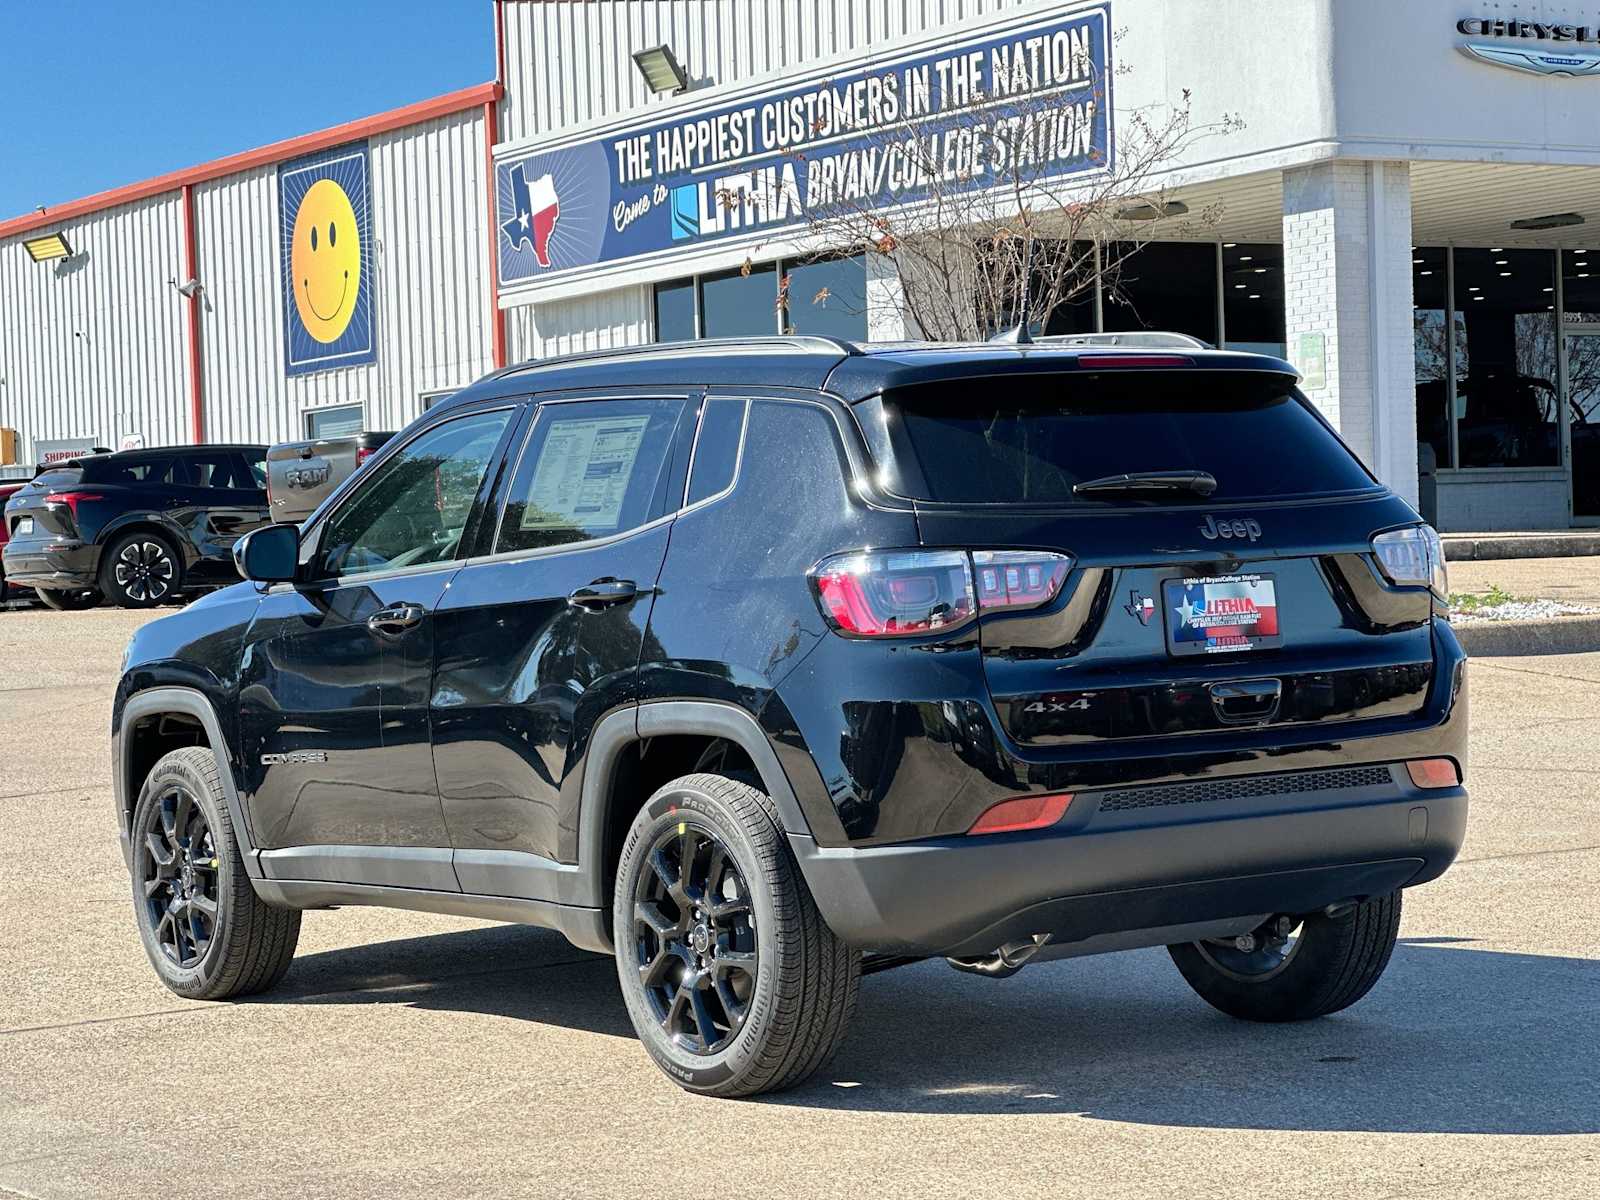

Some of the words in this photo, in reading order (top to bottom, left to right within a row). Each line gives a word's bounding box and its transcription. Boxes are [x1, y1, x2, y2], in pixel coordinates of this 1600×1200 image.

[1456, 17, 1600, 43] CHRYSL
[614, 134, 653, 184] THE
[656, 109, 756, 176] HAPPIEST
[761, 73, 899, 150] CUSTOMERS
[904, 66, 930, 117] IN
[935, 51, 984, 110] THE
[991, 25, 1090, 97] NATION
[612, 194, 650, 232] Come
[653, 183, 668, 206] to
[698, 162, 803, 235] LITHIA
[807, 123, 987, 209] BRYAN/COLLEGE
[990, 101, 1096, 173] STATION
[1198, 514, 1262, 542] Jeep
[1207, 597, 1258, 615] LITHIA
[1023, 698, 1092, 713] 4x4
